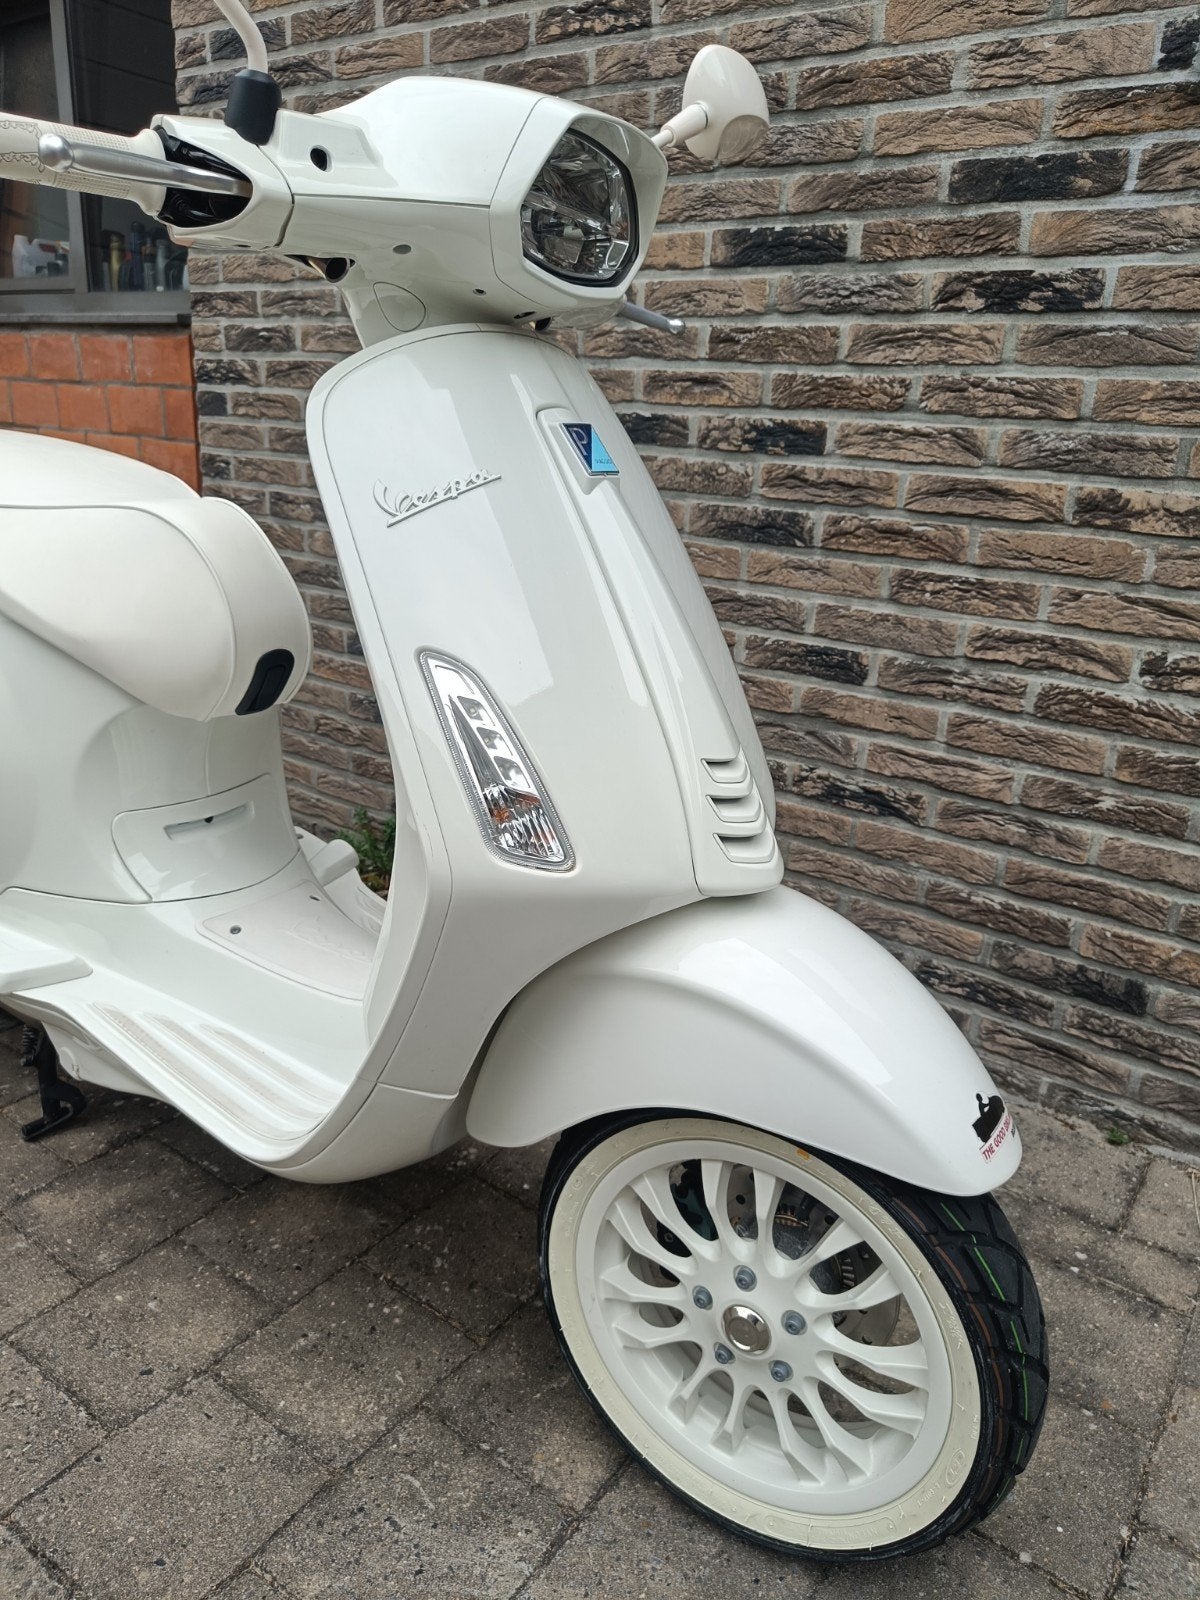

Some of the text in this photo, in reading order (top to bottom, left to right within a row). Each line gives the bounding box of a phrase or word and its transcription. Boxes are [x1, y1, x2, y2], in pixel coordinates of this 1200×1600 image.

[373, 468, 501, 528] Vespa
[982, 1126, 1006, 1160] THE GOOD
